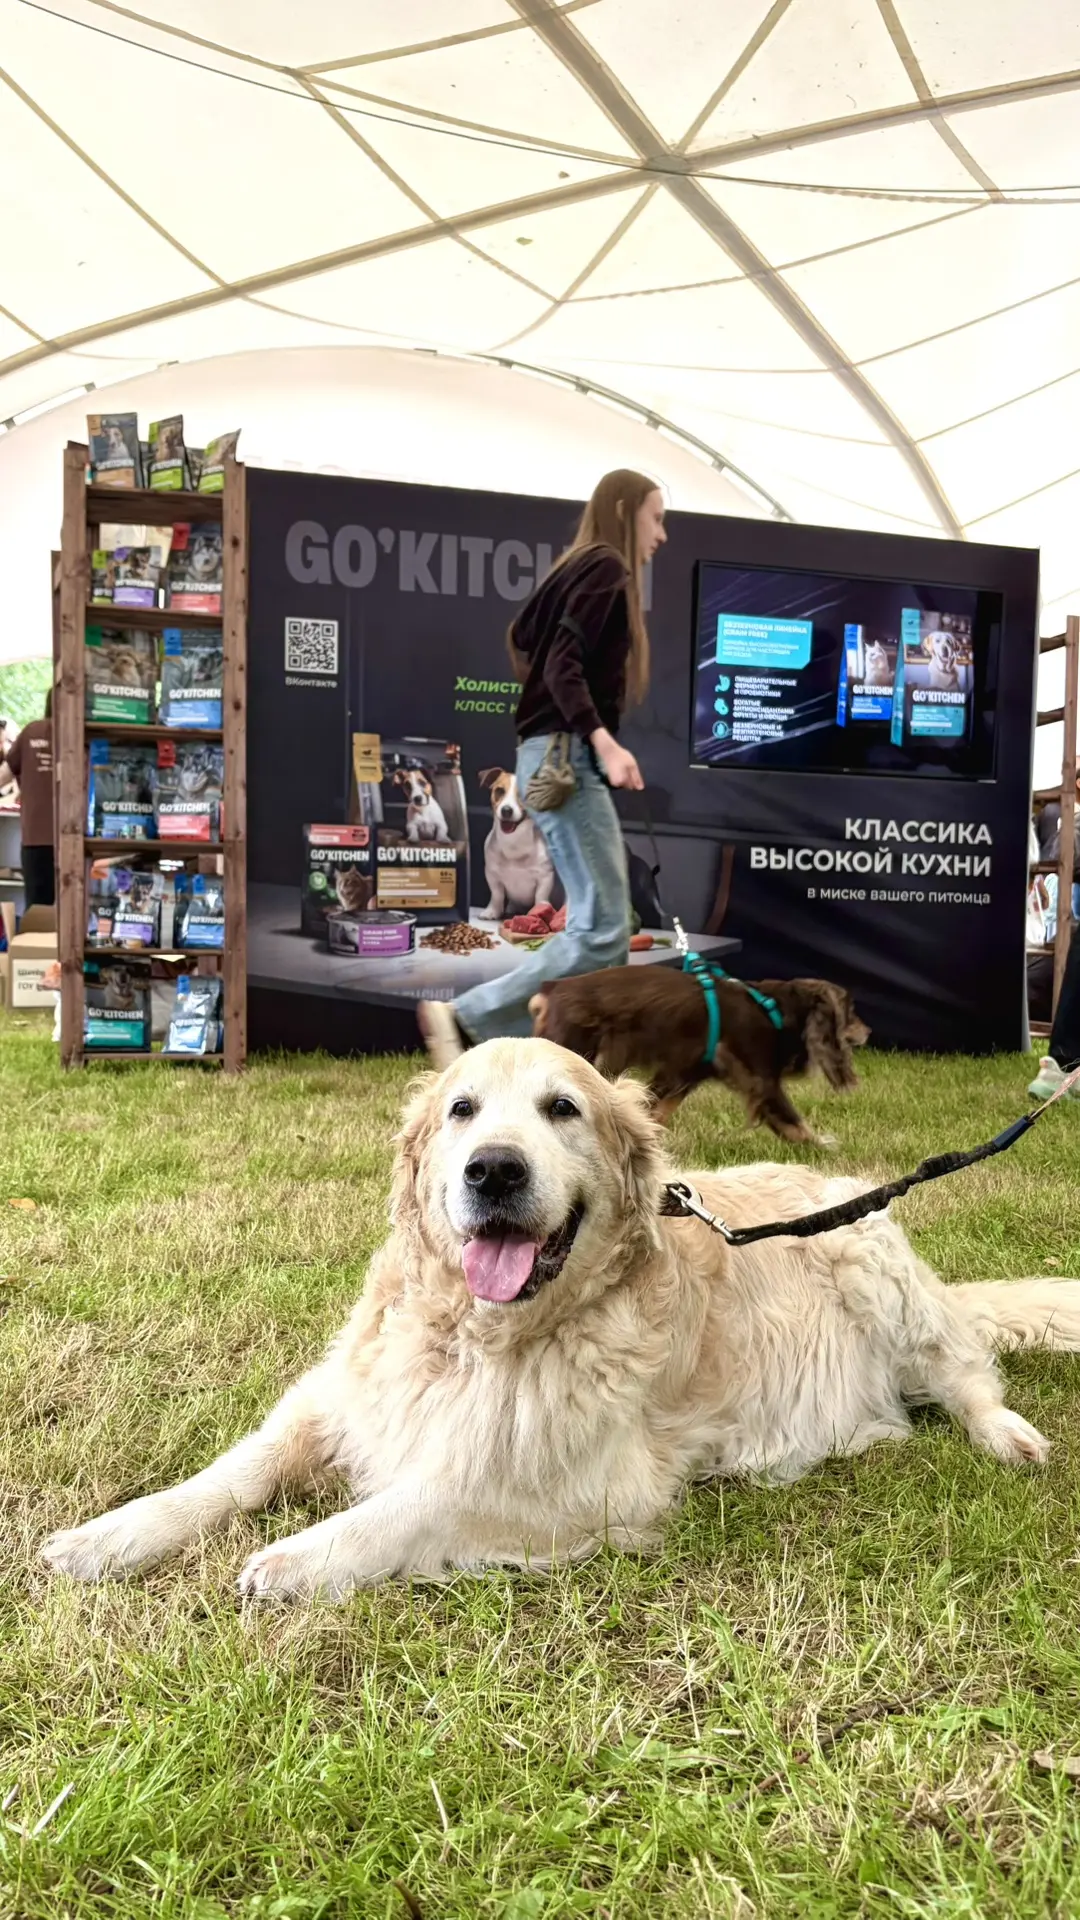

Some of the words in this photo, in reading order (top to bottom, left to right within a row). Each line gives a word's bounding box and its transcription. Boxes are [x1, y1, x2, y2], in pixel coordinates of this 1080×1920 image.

[285, 520, 652, 611] GO'KITC
[93, 683, 149, 699] GO'KITCHEN
[285, 677, 337, 689] ВКонтакте
[912, 690, 966, 704] GO'KITCHEN
[454, 699, 505, 714] класс
[845, 818, 993, 845] КЛАССИКА
[310, 850, 370, 862] GO'KITCHEN
[377, 847, 457, 863] GO'KITCHEN
[750, 847, 892, 874] ВЫСОКОЙ
[901, 853, 991, 877] КУХНИ
[807, 888, 816, 899] в
[820, 888, 866, 900] миске
[870, 889, 925, 902] вашего
[929, 891, 990, 905] питомца
[88, 1007, 143, 1020] GO'KITCHEN
